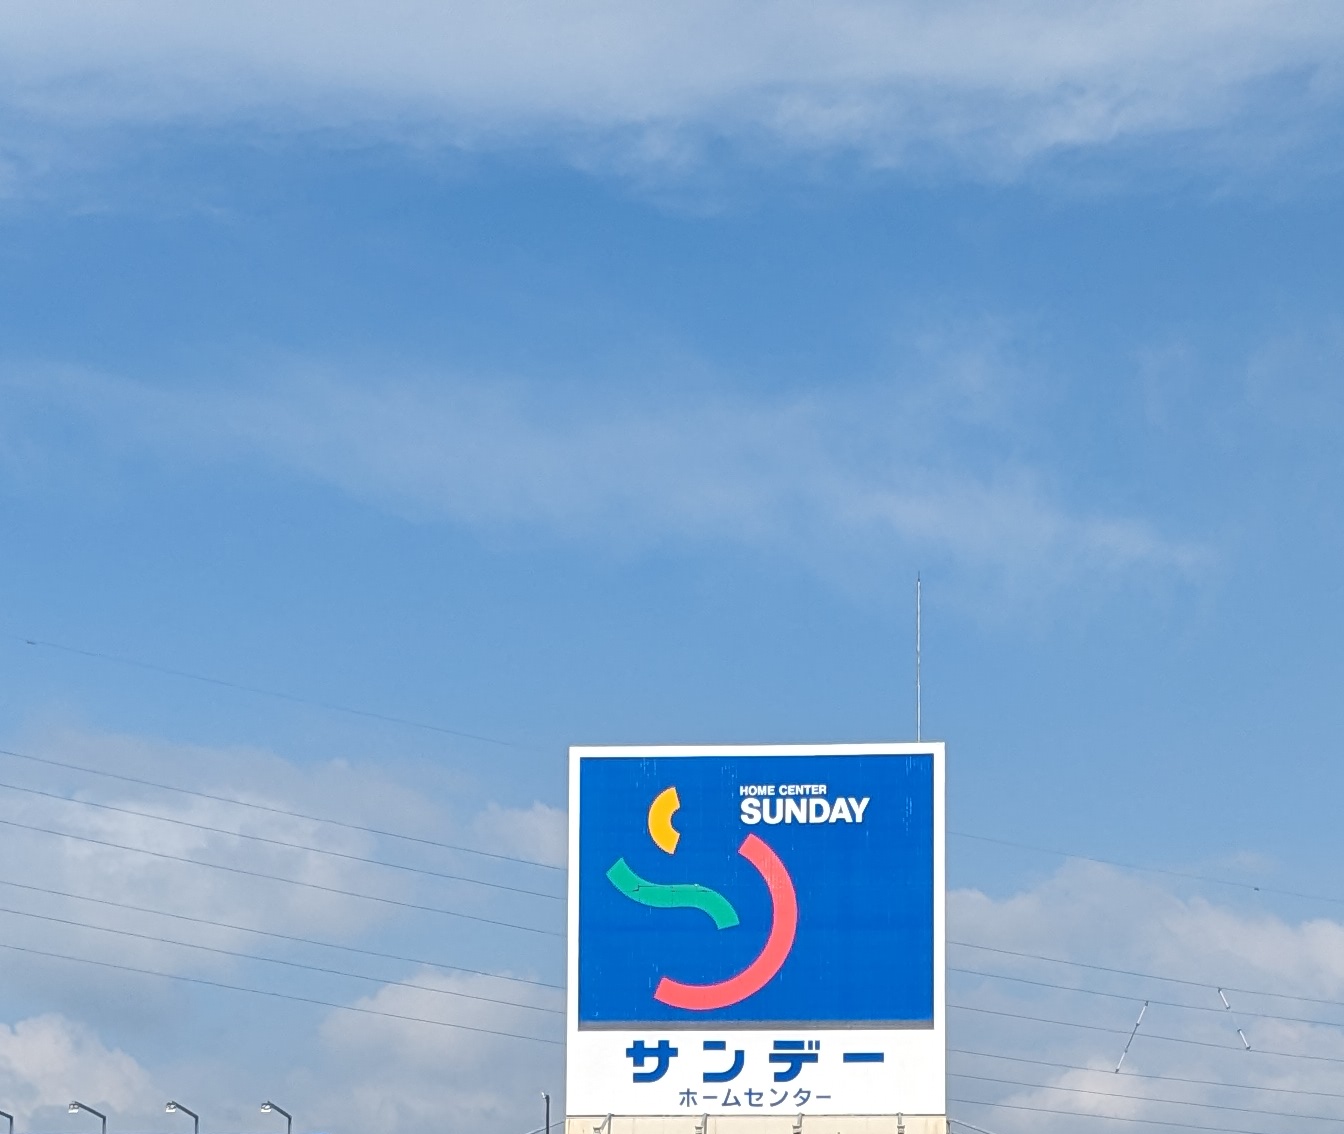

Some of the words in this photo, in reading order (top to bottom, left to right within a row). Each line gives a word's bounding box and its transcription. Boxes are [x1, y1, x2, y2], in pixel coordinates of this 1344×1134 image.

[739, 785, 775, 796] HOME
[779, 785, 827, 796] CENTER
[740, 797, 870, 825] SUNDAY
[625, 1040, 885, 1083] サンデー
[679, 1088, 832, 1107] ホームセンター
